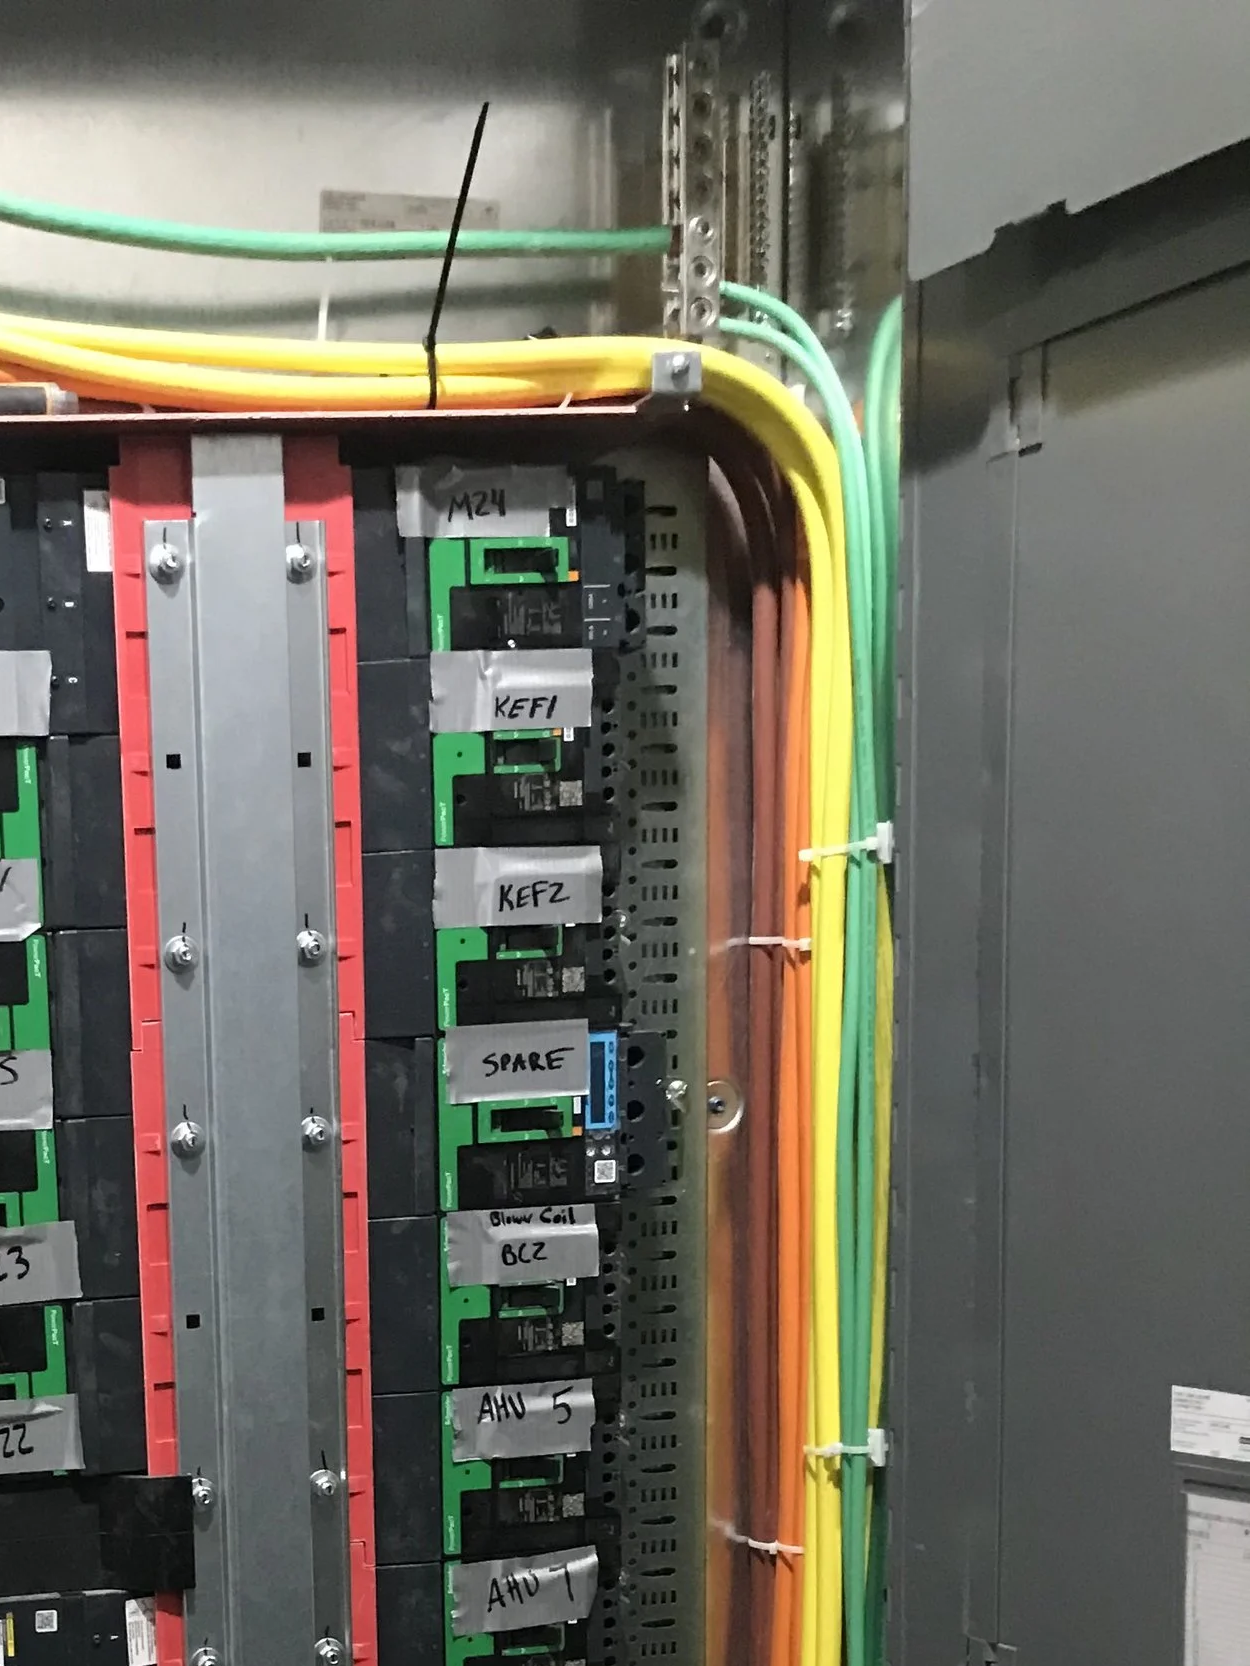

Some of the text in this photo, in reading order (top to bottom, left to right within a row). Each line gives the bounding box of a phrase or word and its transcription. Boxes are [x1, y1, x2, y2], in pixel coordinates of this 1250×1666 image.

[448, 488, 506, 522] M24
[494, 694, 557, 720] KEF1
[498, 881, 570, 912] KEF2
[483, 1046, 574, 1075] SPARE
[540, 1206, 577, 1226] Coil
[478, 1386, 574, 1425] AHU 5
[487, 1575, 540, 1613] AHU
